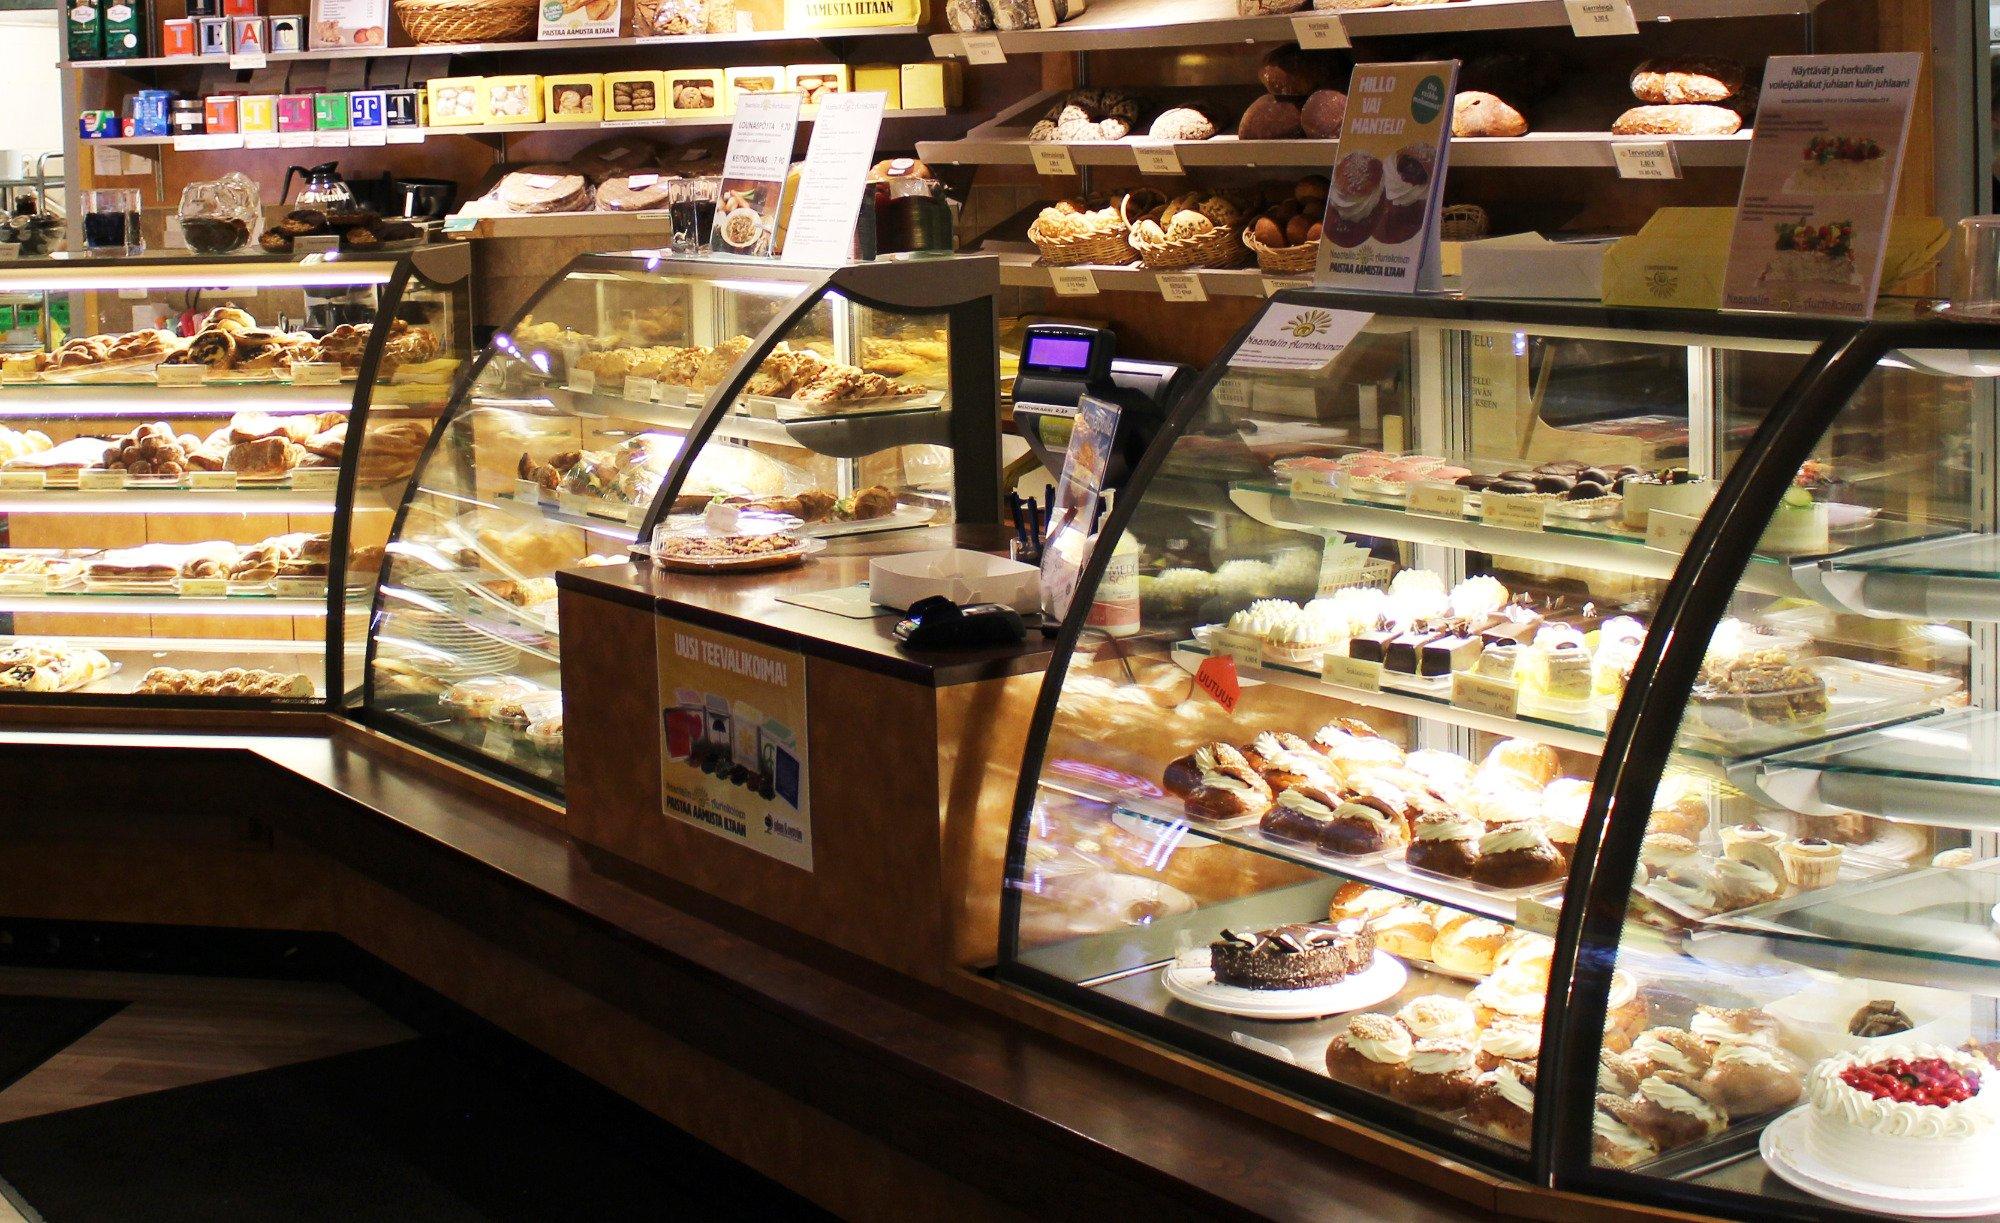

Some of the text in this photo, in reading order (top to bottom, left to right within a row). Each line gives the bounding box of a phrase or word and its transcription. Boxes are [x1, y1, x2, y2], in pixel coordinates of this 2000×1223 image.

[855, 0, 894, 15] ILTAAN
[170, 26, 188, 48] T
[240, 23, 259, 45] A
[1791, 64, 1885, 78] Näyttävät ja herkulliset
[1358, 76, 1396, 93] HILLO
[1769, 77, 1910, 91] voileipäkakut juhlaan kuin juhlaan!
[1362, 98, 1382, 114] VAI
[1351, 118, 1406, 135] MANTELI?
[1329, 261, 1406, 278] PAISTAA AAMUSTA ILTAAN
[1244, 335, 1345, 352] Naantalin Aurinkoinen
[675, 632, 788, 688] UUSI TEEVALIKOIMA!
[1199, 672, 1233, 708] UUTUUS
